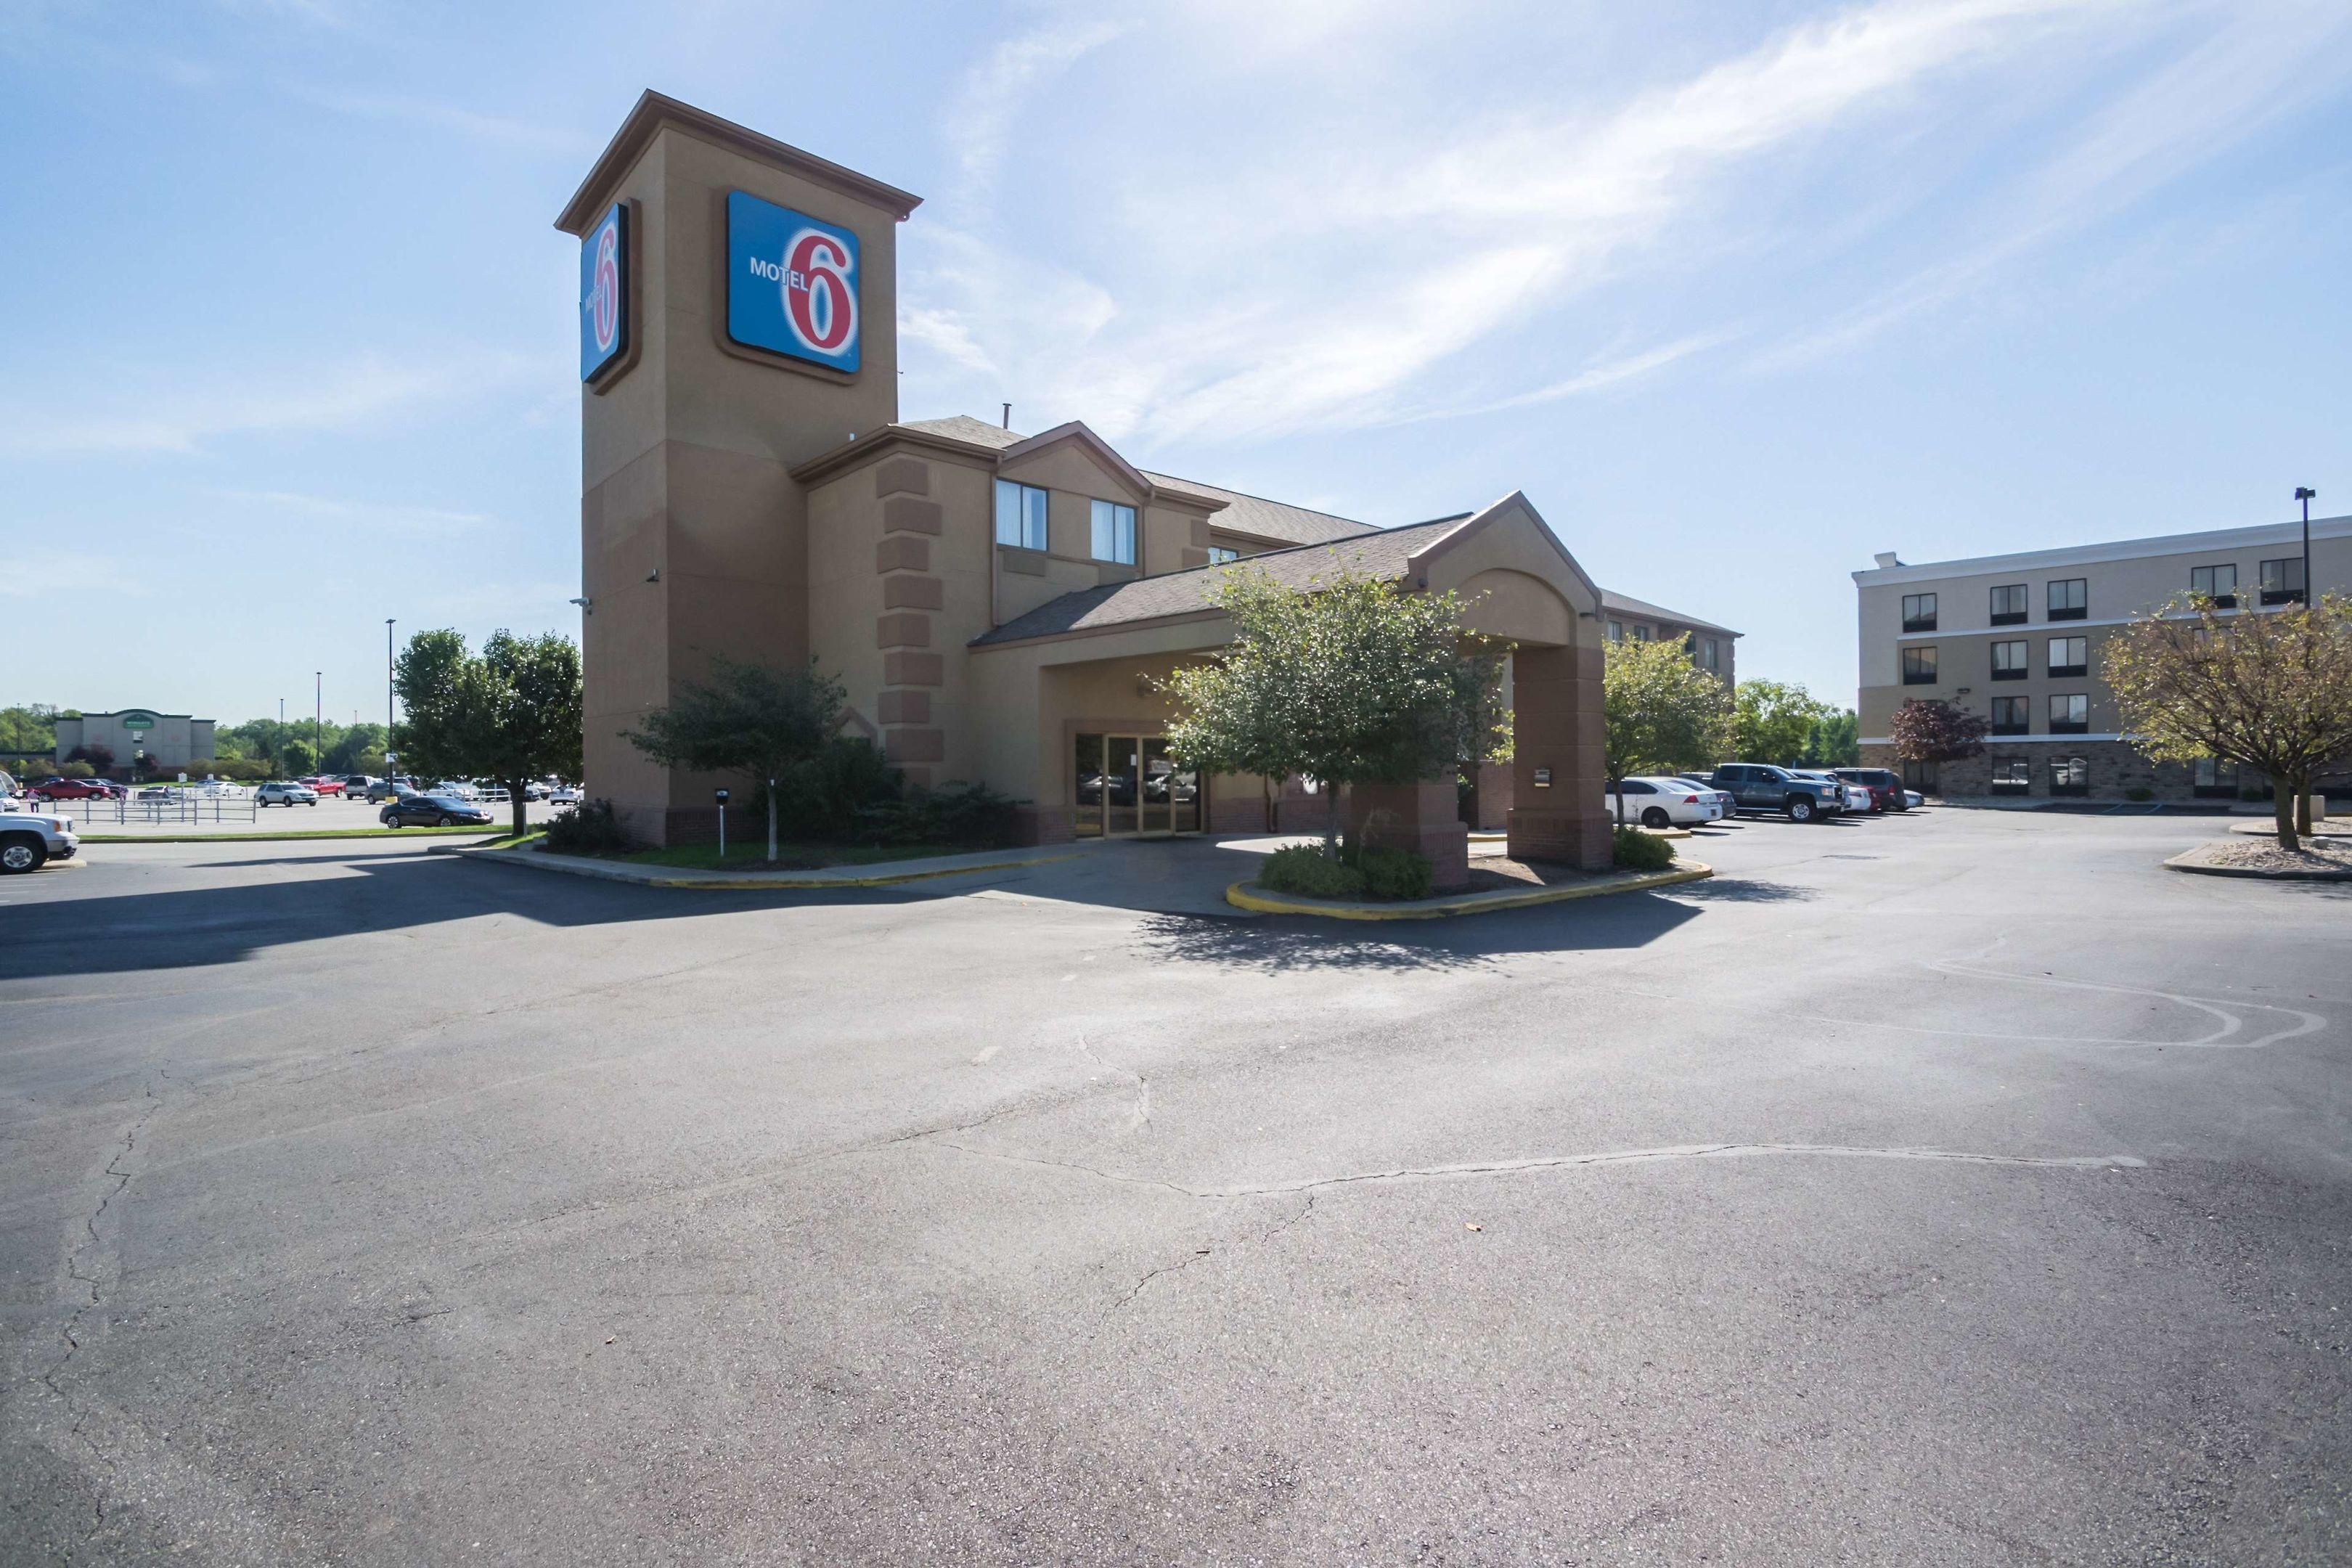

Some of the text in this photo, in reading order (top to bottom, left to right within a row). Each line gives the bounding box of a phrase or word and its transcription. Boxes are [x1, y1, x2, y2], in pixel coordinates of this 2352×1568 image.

[595, 227, 617, 347] 6
[750, 234, 852, 350] MOTEL 6
